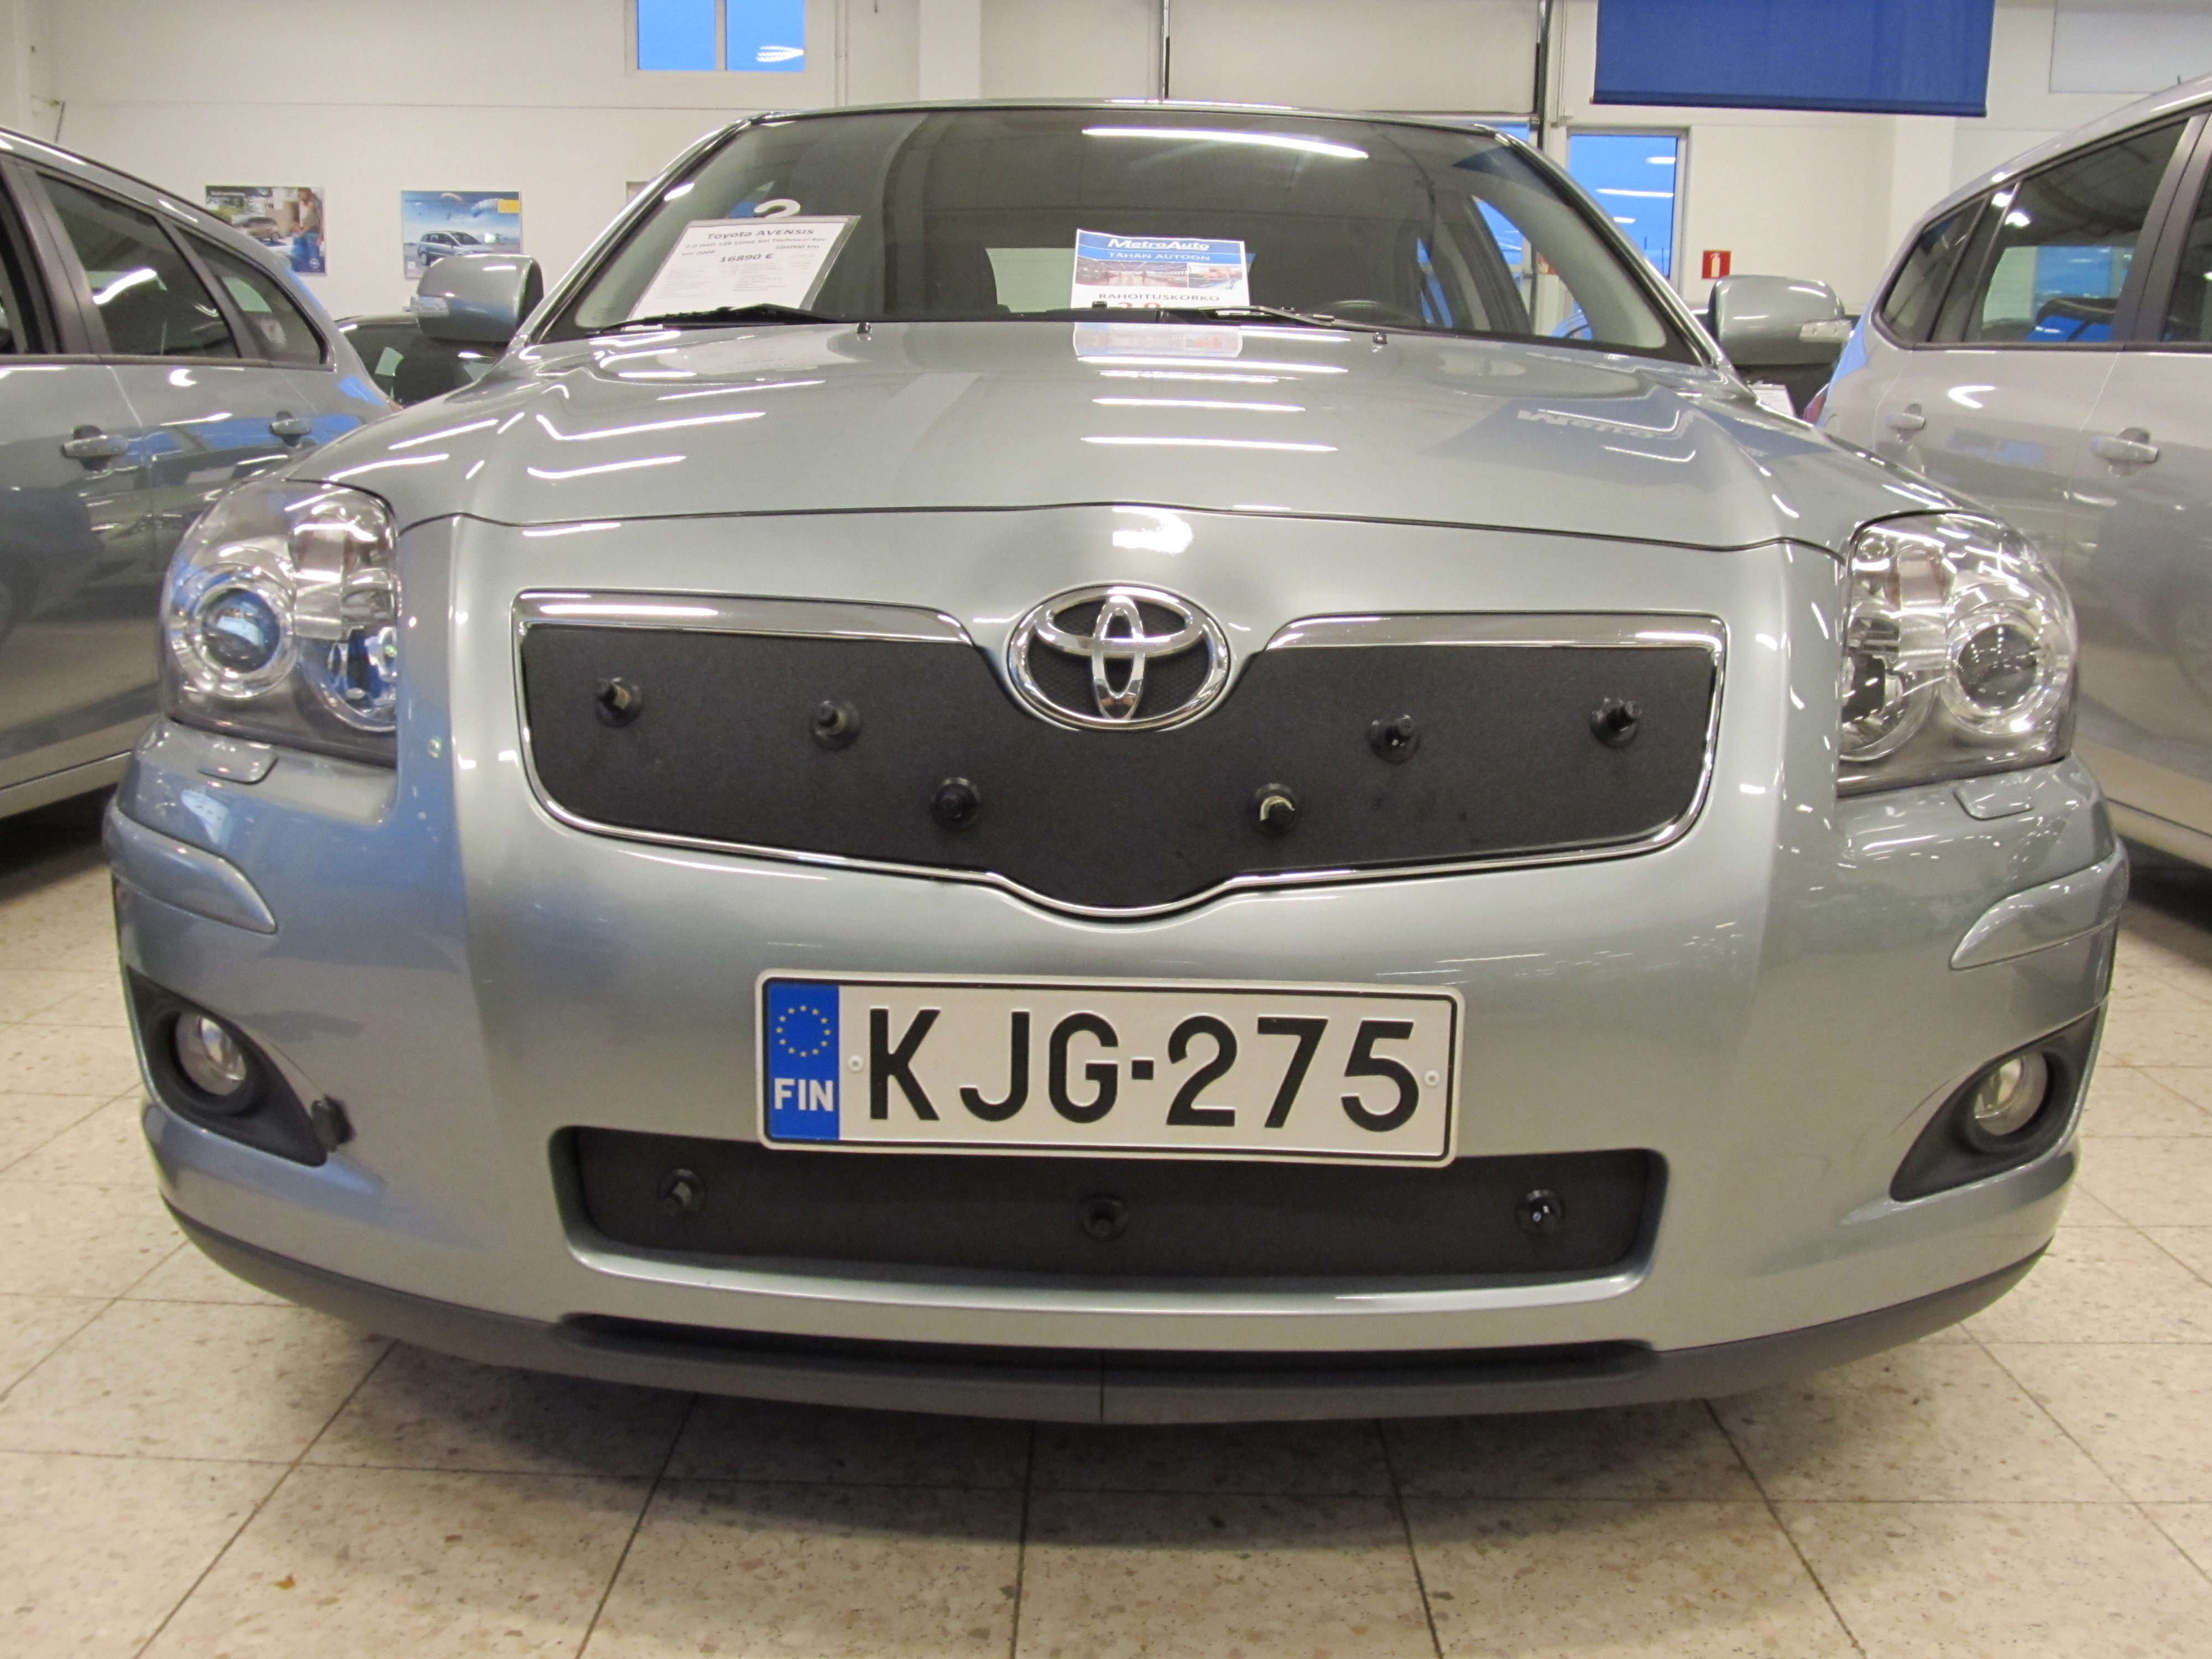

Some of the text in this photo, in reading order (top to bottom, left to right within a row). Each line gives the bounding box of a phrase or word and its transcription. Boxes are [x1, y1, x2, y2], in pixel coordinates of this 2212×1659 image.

[1108, 238, 1210, 251] MetroAuto
[719, 254, 761, 262] 16890
[868, 1007, 1420, 1132] KJG-275
[773, 1077, 834, 1112] FIN
